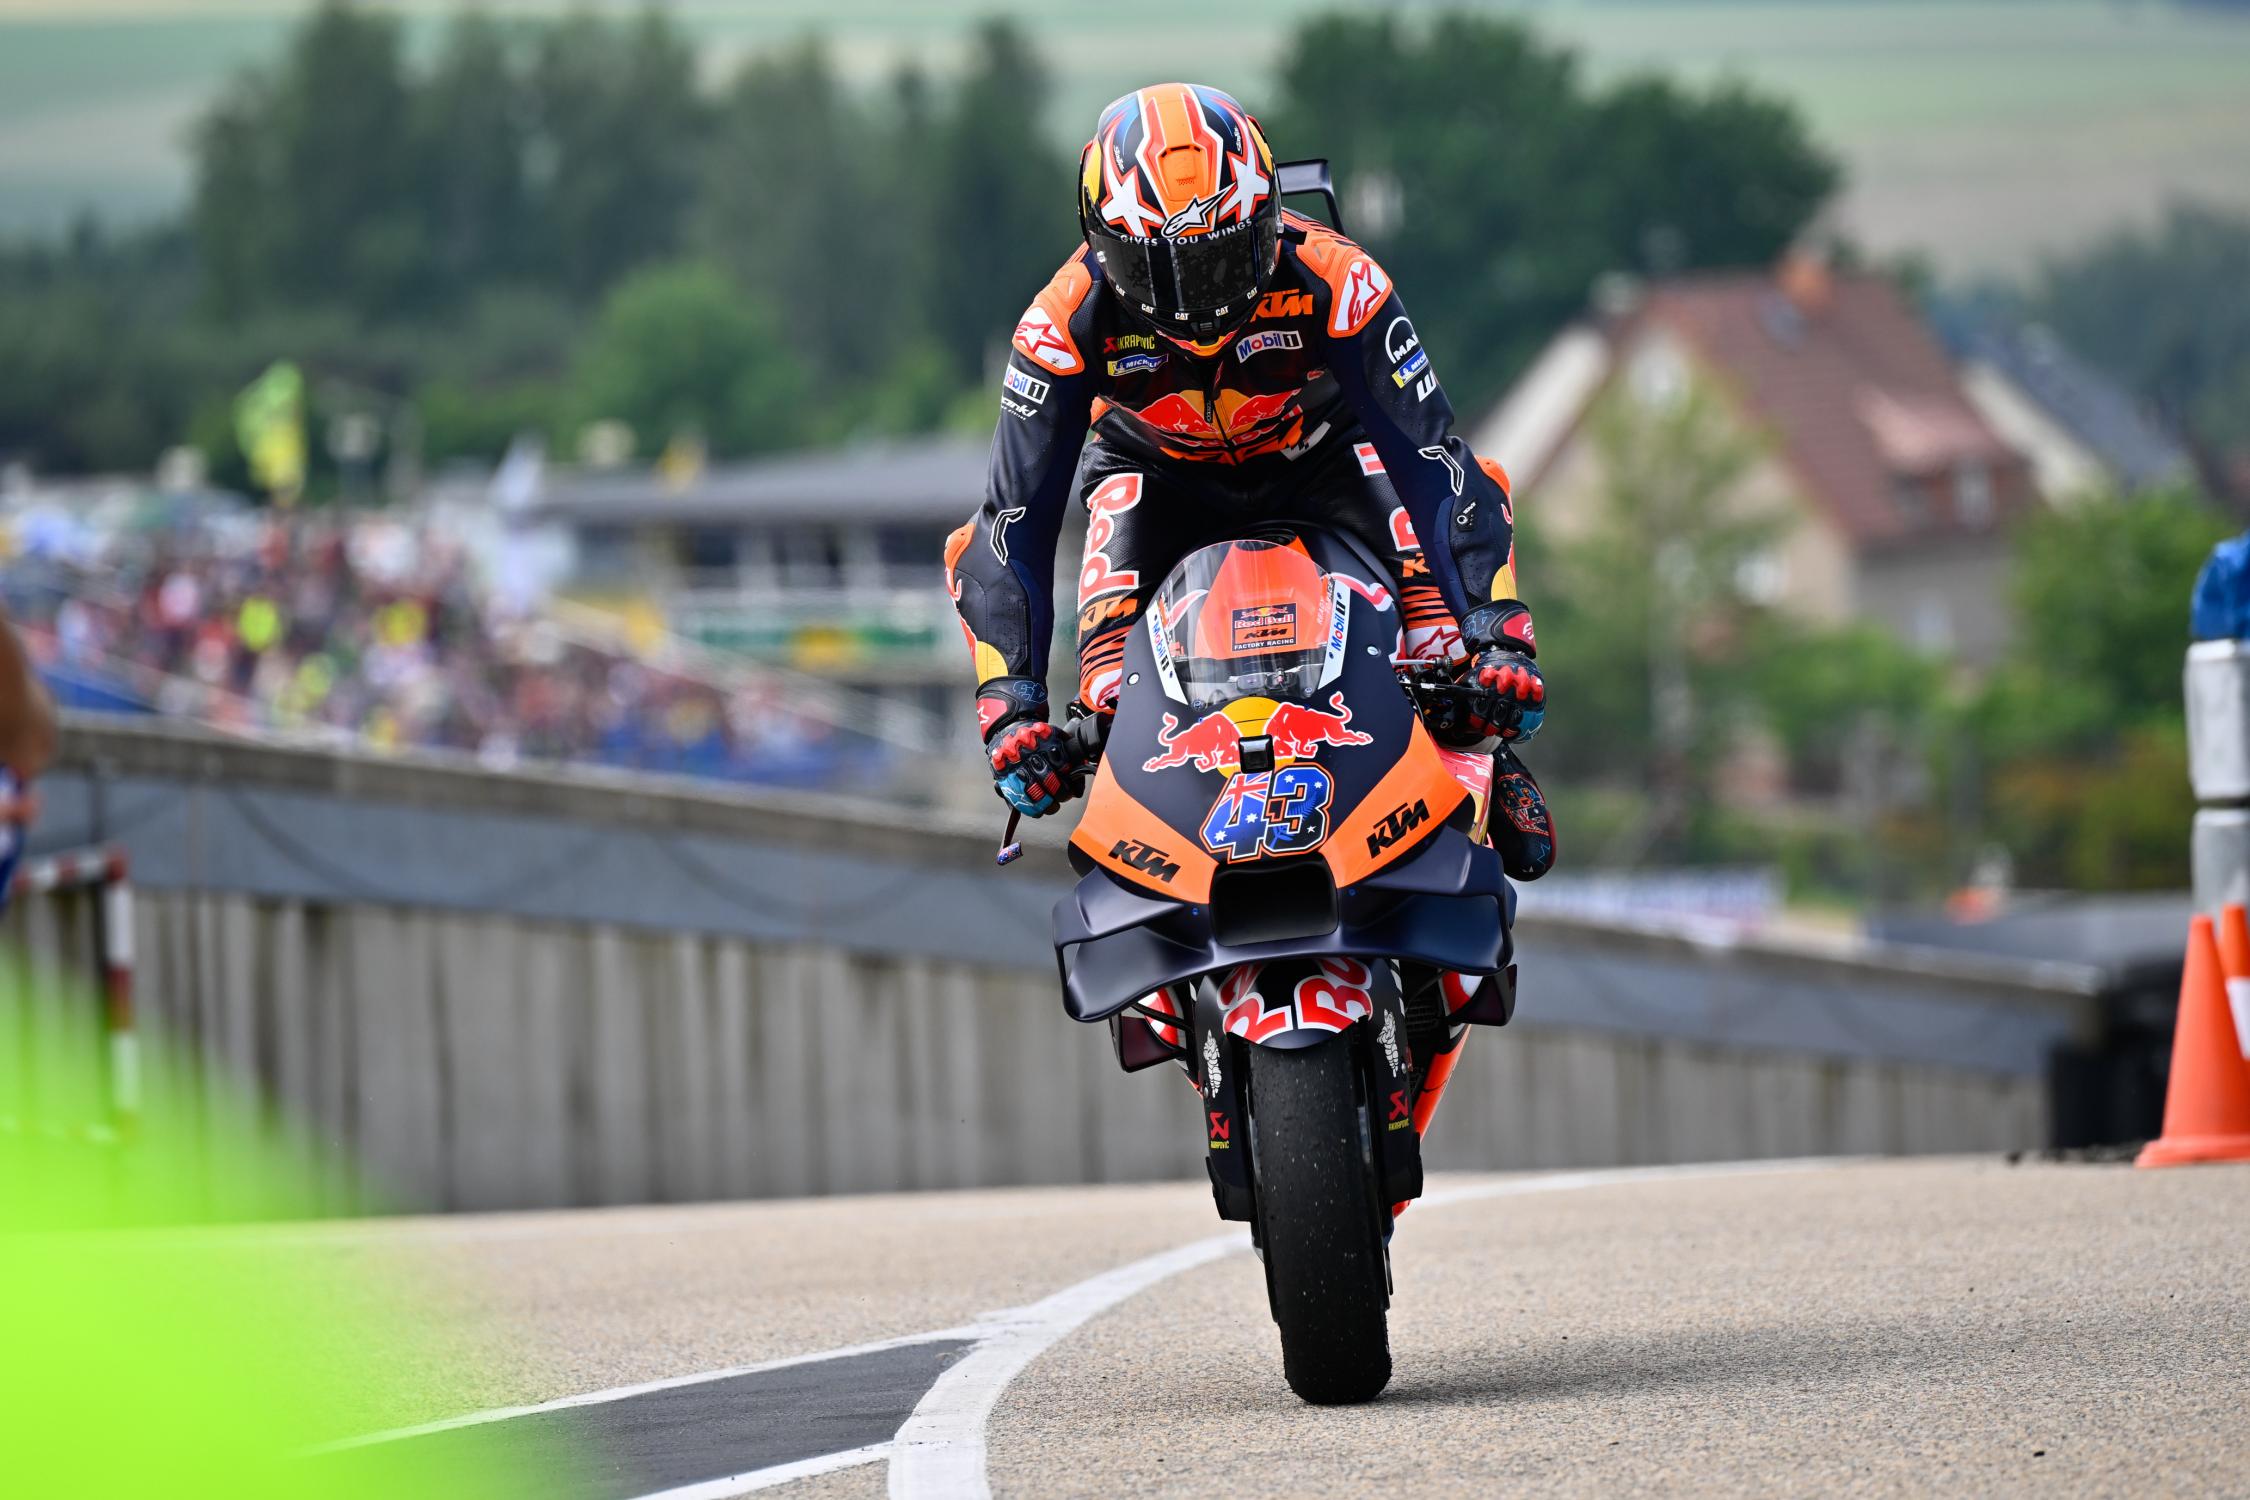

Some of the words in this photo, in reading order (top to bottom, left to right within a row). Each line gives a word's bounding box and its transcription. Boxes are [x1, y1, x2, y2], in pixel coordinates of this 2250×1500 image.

[1120, 234, 1158, 247] GIVES
[1167, 236, 1199, 246] YOU
[1208, 220, 1253, 242] WINGS
[1115, 285, 1127, 297] CAT
[1246, 286, 1258, 300] CAT
[1141, 303, 1155, 315] CAT
[1174, 312, 1190, 321] CAT
[1215, 305, 1230, 317] CAT
[1249, 288, 1314, 323] KTM
[1238, 332, 1283, 359] Mobil
[1285, 333, 1298, 348] 1
[1079, 596, 1138, 641] KTM
[1234, 616, 1264, 629] Red
[1264, 613, 1294, 625] Bull
[1153, 621, 1168, 658] Mobil
[1234, 641, 1265, 651] FACTORY
[1266, 638, 1294, 647] RACING
[1244, 628, 1288, 639] KTM
[1331, 613, 1345, 652] Mobil
[1201, 763, 1333, 863] 43
[1366, 799, 1431, 859] KTM
[1108, 839, 1181, 884] KTM
